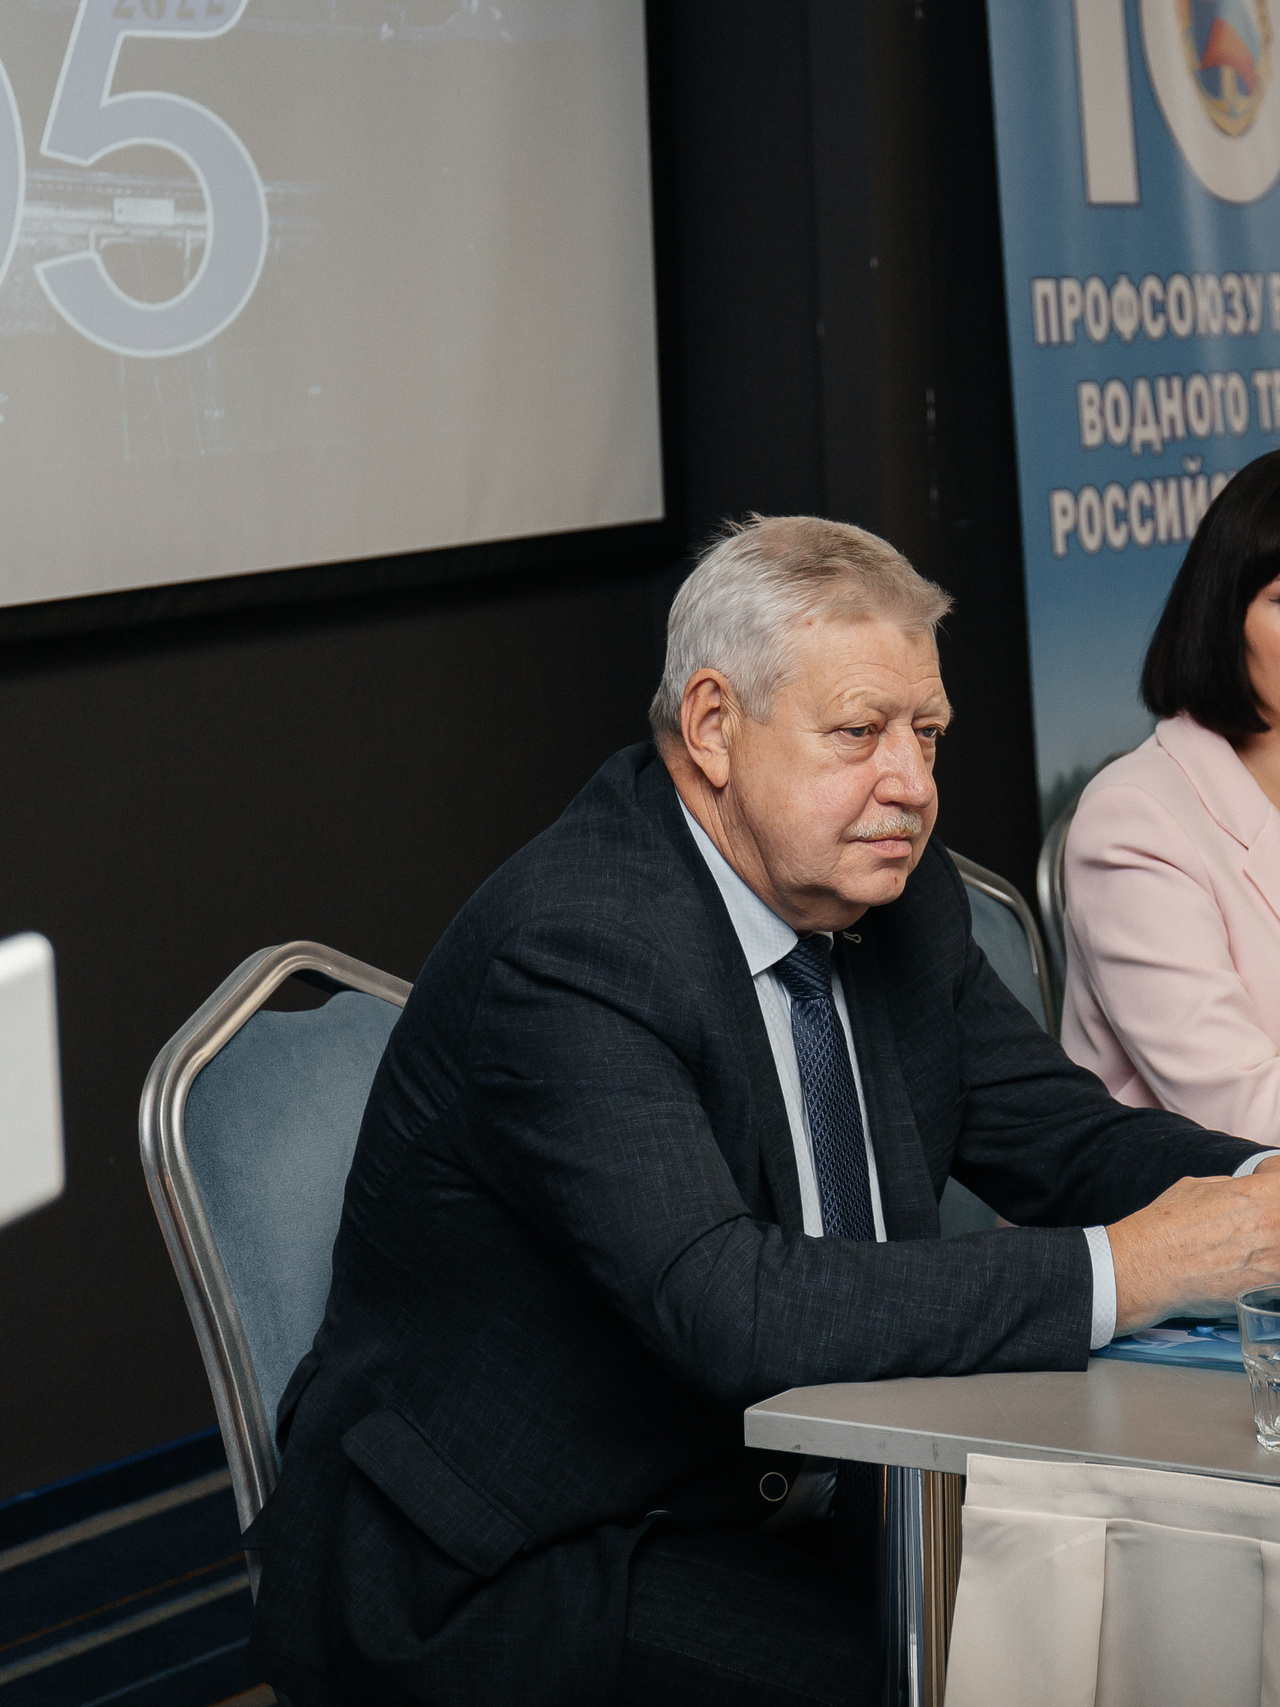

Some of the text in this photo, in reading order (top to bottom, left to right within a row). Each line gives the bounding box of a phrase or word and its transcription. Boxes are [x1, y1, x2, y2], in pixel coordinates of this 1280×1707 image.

[1031, 270, 1265, 346] ПРОФСОЮЗУ
[1077, 370, 1250, 455] ВОДНОГО
[1049, 456, 1236, 558] РОССИЙ
